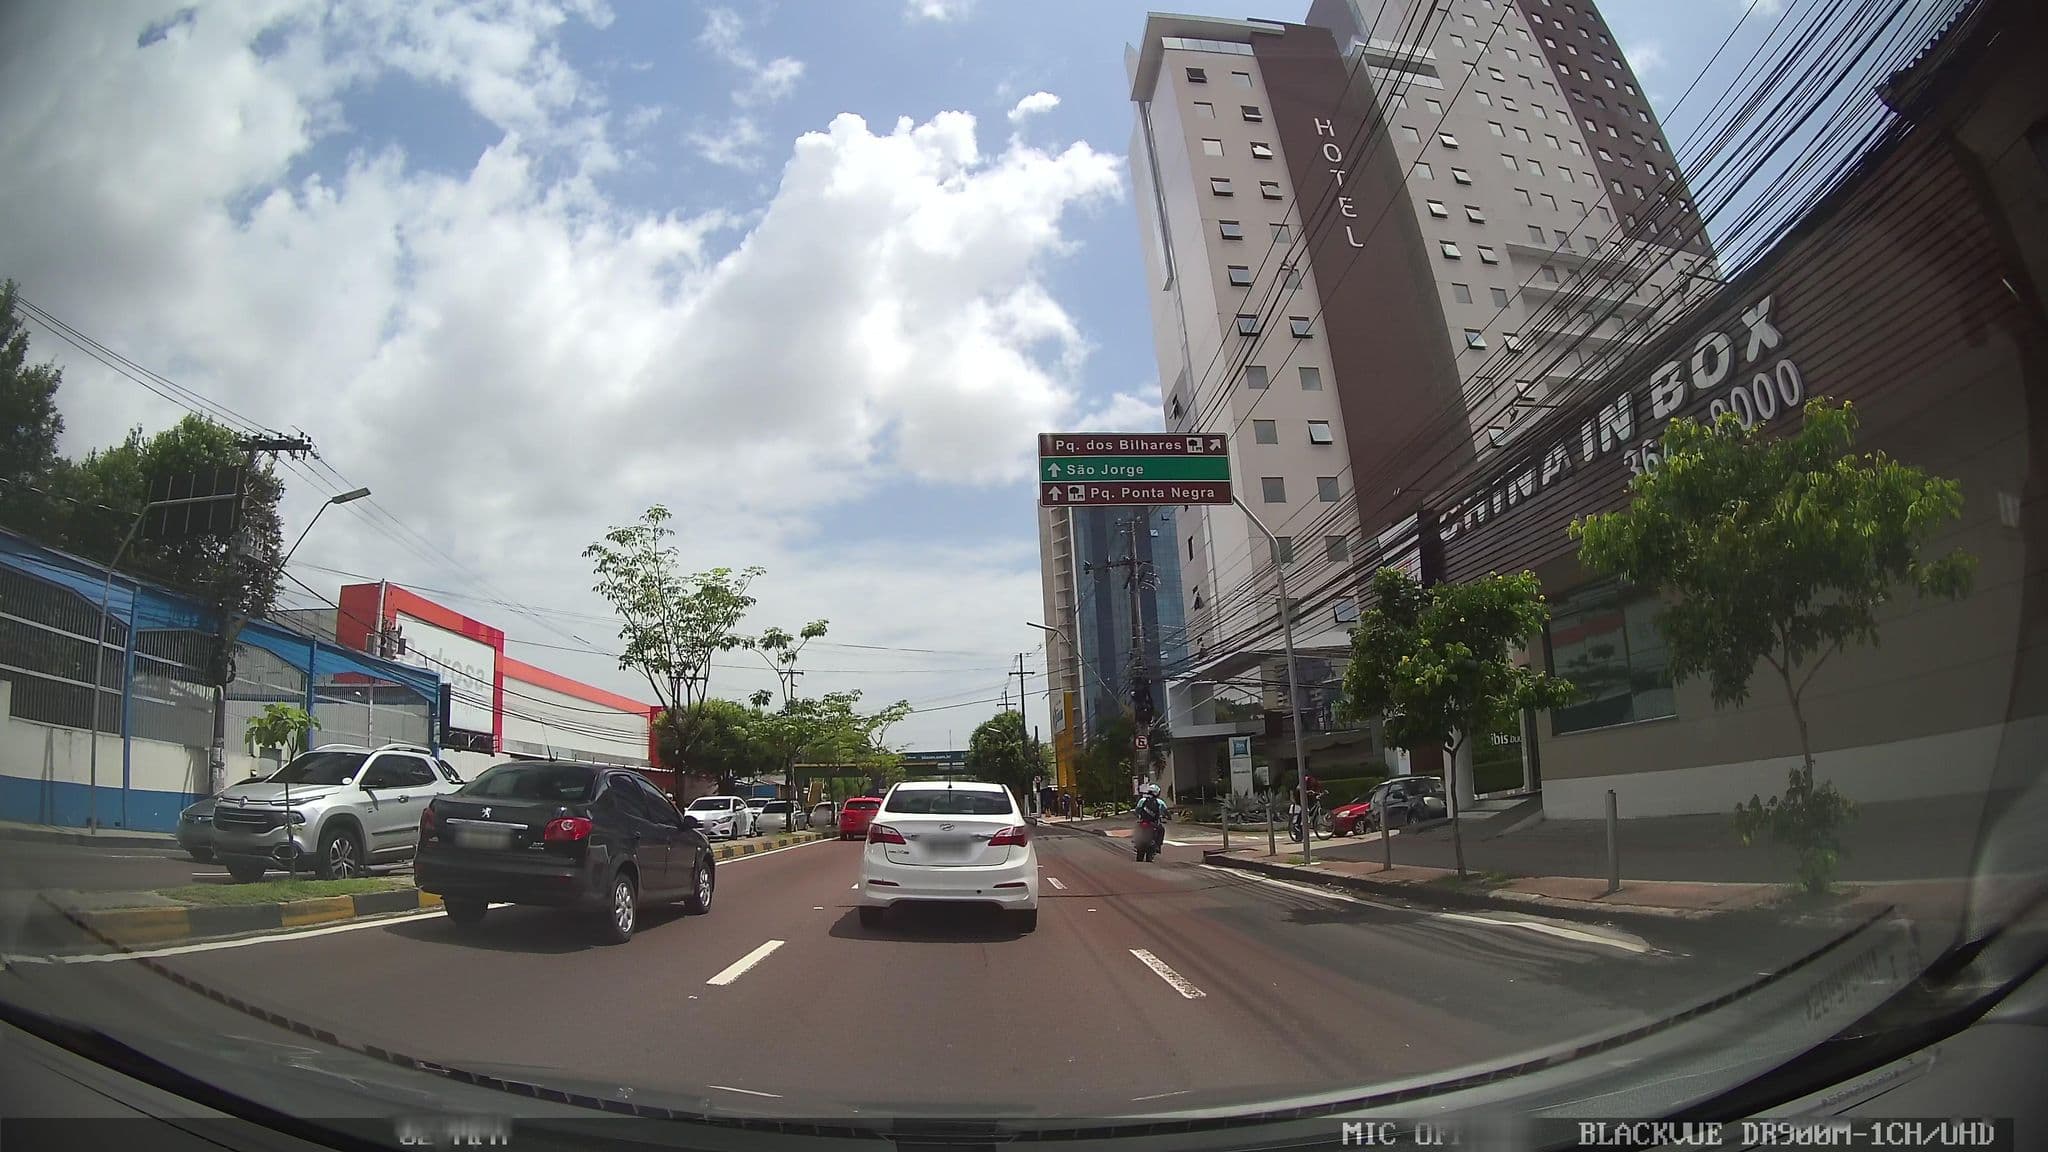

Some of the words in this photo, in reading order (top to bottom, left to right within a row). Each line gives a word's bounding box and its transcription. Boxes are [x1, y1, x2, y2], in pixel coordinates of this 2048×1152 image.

[1314, 118, 1364, 247] HOTEL
[1439, 442, 1572, 542] CHINA
[1581, 391, 1636, 463] IN
[1650, 295, 1783, 420] BOX
[1055, 440, 1079, 452] Pq.
[1086, 439, 1113, 450] dos
[1119, 439, 1182, 450] Bilhares
[1066, 464, 1095, 475] São
[1101, 464, 1144, 477] Jorge
[1090, 487, 1115, 500] Pq.
[1121, 487, 1165, 498] Ponta
[1171, 487, 1215, 500] Negra
